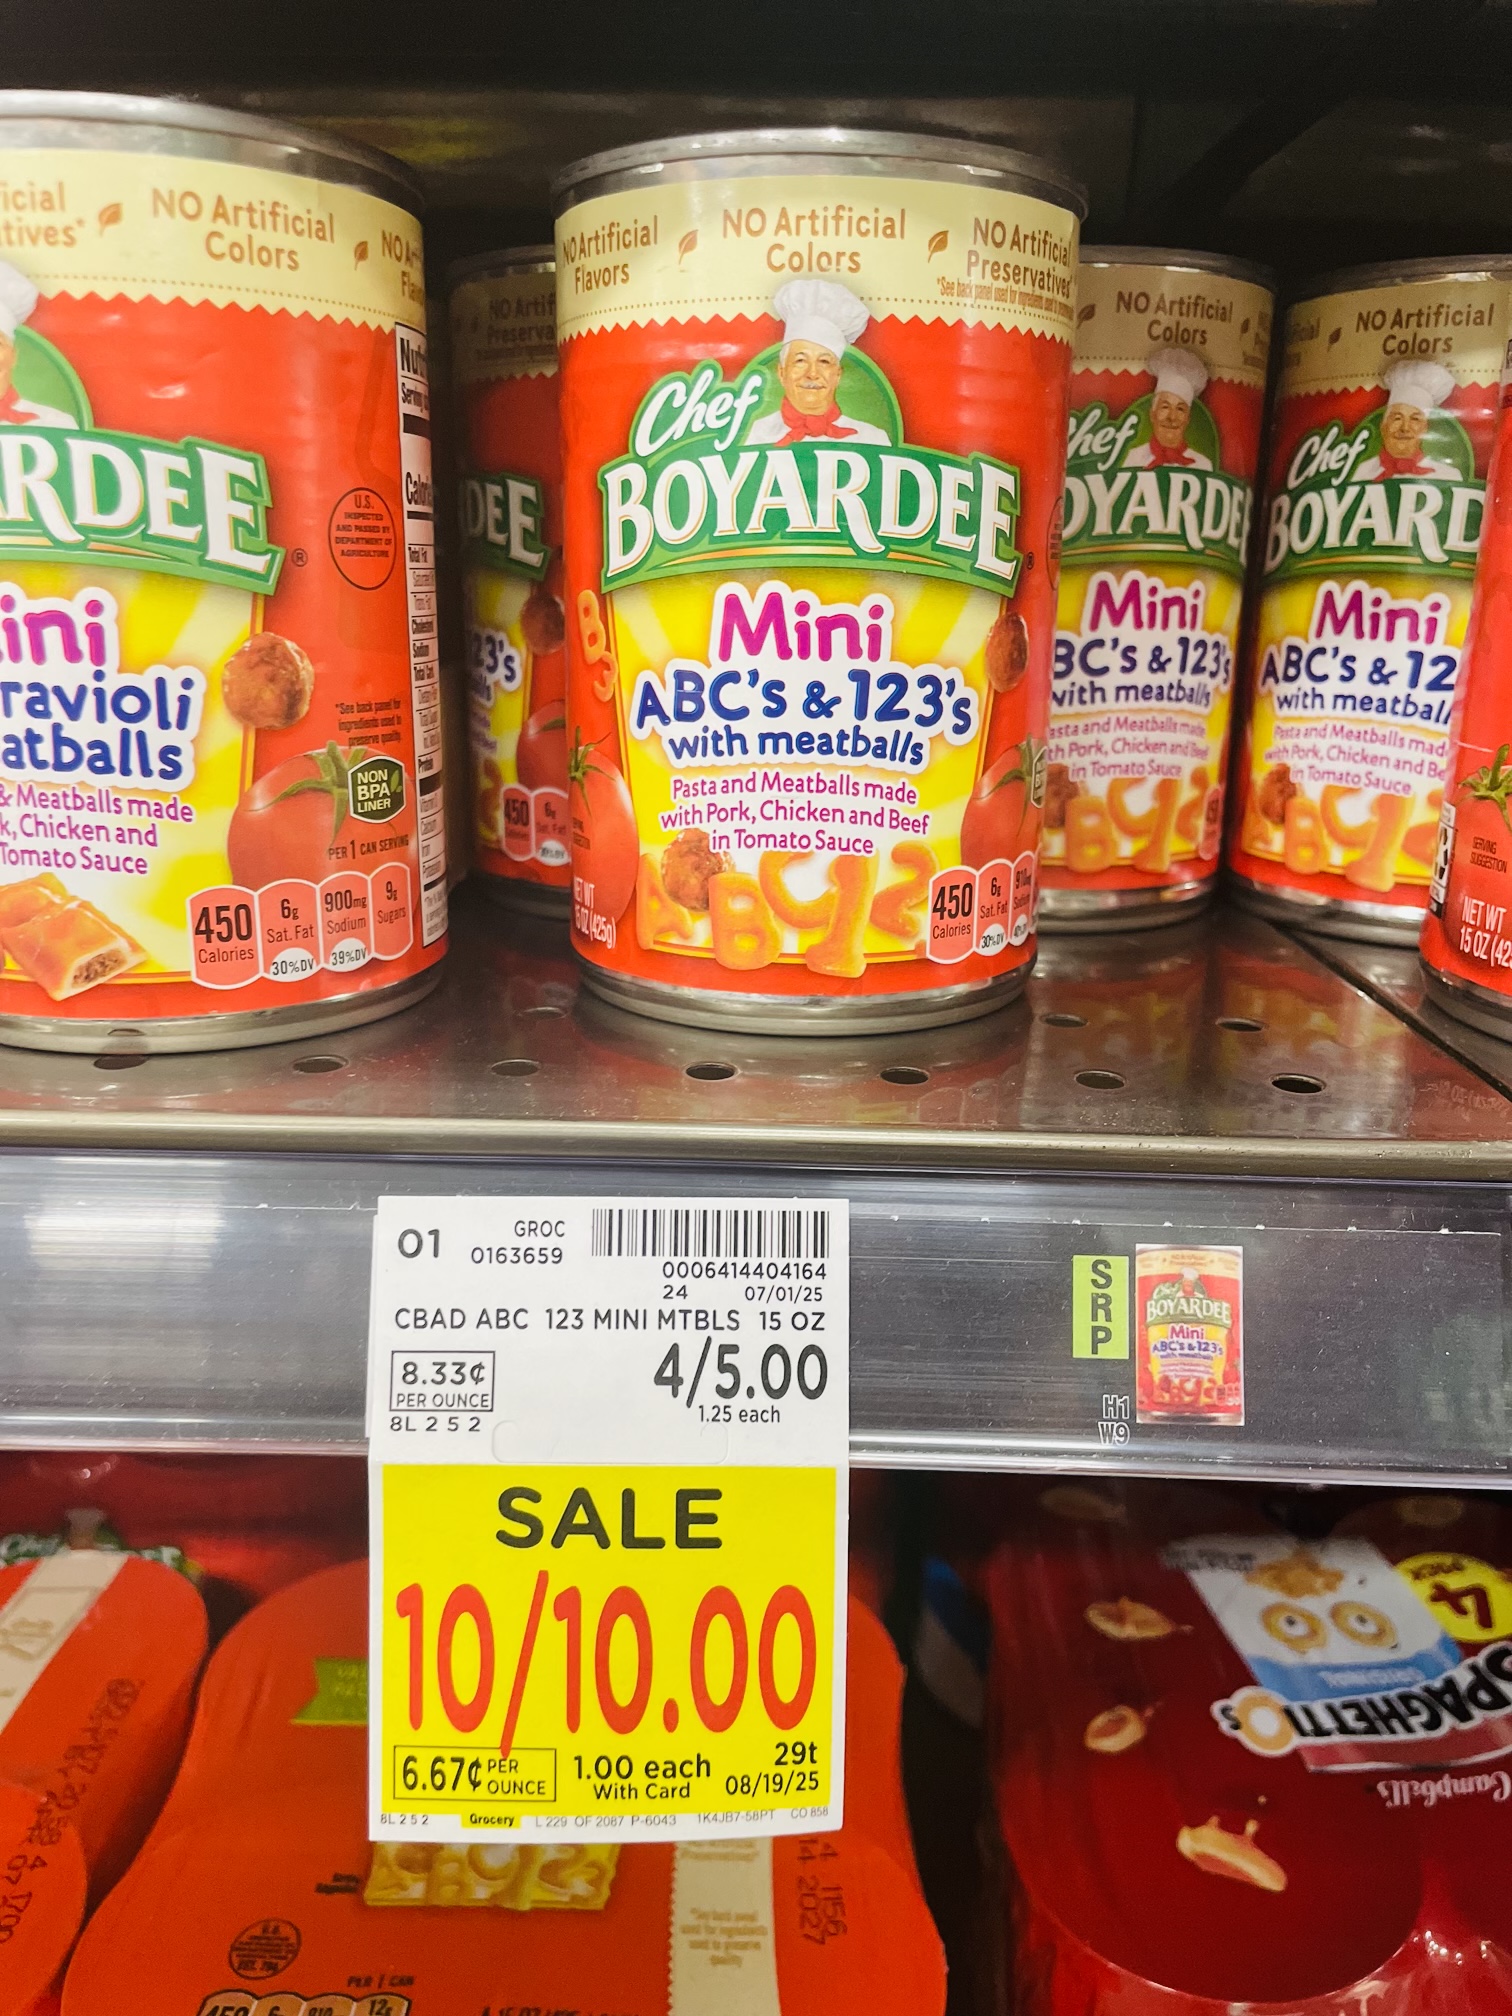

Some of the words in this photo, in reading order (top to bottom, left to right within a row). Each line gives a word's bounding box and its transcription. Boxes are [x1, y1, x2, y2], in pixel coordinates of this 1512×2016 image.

[152, 188, 203, 221] NO
[211, 195, 335, 243] Artificial
[722, 207, 767, 239] NO
[775, 205, 906, 240] Artificial
[381, 230, 403, 263] NO
[579, 215, 658, 260] Artificial
[974, 217, 1006, 249] NO
[1010, 224, 1072, 268] Artificial
[205, 231, 300, 272] Colors
[766, 241, 861, 274] Colors
[575, 262, 630, 296] Flavors
[1116, 292, 1150, 314] NO
[1155, 296, 1233, 323] Artificial
[1355, 309, 1386, 332] NO
[1390, 303, 1494, 330] Artificial
[1147, 319, 1207, 346] Colors
[1382, 333, 1452, 356] Colors
[634, 369, 764, 457] Chef
[1287, 428, 1369, 490] Chef
[604, 449, 1018, 580] BOYARDEE
[1089, 579, 1200, 632] Mini
[1315, 589, 1441, 645] Mini
[0, 594, 107, 667] ini
[718, 591, 884, 663] Mini
[1148, 650, 1172, 674] &
[1177, 636, 1231, 685] 123's
[1261, 645, 1357, 687] ABC's
[1367, 658, 1397, 685] &
[636, 668, 786, 730] ABC's
[803, 676, 841, 718] &
[848, 669, 972, 736] 123's
[1114, 680, 1212, 708] meatballs
[1276, 688, 1325, 713] with
[1082, 718, 1111, 735] and
[1113, 717, 1178, 733] Meatballs
[1332, 724, 1405, 749] Meatballs
[669, 727, 748, 760] with
[758, 727, 924, 766] meatballs
[1068, 740, 1108, 758] Pork,
[1111, 738, 1168, 755] Chicken
[1090, 761, 1146, 778] Tomato
[1148, 760, 1183, 777] Sauce
[1326, 745, 1390, 768] Chicken
[1393, 758, 1425, 777] and
[357, 769, 388, 784] NON
[672, 777, 717, 800] Pasta
[720, 773, 757, 796] and
[760, 771, 860, 797] Meatballs
[864, 780, 918, 806] made
[1308, 765, 1362, 786] Tomato
[1365, 772, 1412, 795] Sauce
[16, 786, 122, 816] Meatballs
[128, 793, 194, 823] made
[357, 784, 391, 801] BPA
[357, 798, 391, 813] LINER
[19, 812, 109, 843] Chicken
[116, 822, 158, 848] and
[660, 804, 703, 831] with
[706, 804, 756, 826] Pork,
[760, 801, 846, 823] Chicken
[849, 806, 885, 828] and
[888, 812, 930, 837] Beef
[329, 848, 348, 860] PER
[350, 840, 356, 859] 1
[361, 843, 377, 855] CAN
[380, 834, 409, 851] SERVING
[712, 830, 731, 850] in
[734, 829, 812, 854] Tomato
[815, 832, 874, 856] Sauce
[1472, 836, 1497, 855] SERVING
[0, 842, 76, 869] Tomato
[81, 849, 148, 875] Sauce
[1470, 852, 1507, 874] SUGGESTION
[386, 881, 398, 901] 9g
[991, 877, 1002, 897] 6g
[281, 899, 299, 920] 6g
[325, 889, 367, 912] 900mg
[932, 882, 973, 921] 450
[980, 905, 996, 919] Sat.
[997, 901, 1009, 915] Fat
[195, 904, 252, 943] 450
[327, 916, 367, 935] Sodium
[377, 907, 406, 925] Sugars
[1462, 896, 1485, 926] NET
[1485, 901, 1507, 934] WT
[267, 929, 293, 944] Sat.
[295, 924, 315, 939] Fat
[932, 923, 972, 940] Calories
[1459, 925, 1473, 954] 15
[1473, 931, 1491, 960] OZ
[199, 947, 254, 964] Calories
[272, 958, 315, 976] 30%DV
[331, 948, 367, 966] 39%DV
[514, 1220, 566, 1239] GROC
[397, 1228, 442, 1259] 01
[470, 1246, 564, 1266] 0163659
[662, 1261, 827, 1281] 0006414404164
[663, 1285, 688, 1301] 24
[744, 1285, 823, 1304] 07/01/25
[395, 1308, 467, 1331] CBAD
[475, 1308, 529, 1331] ABC
[545, 1309, 584, 1331] 123
[594, 1309, 648, 1331] MINI
[658, 1310, 740, 1332] MTBLS
[759, 1311, 782, 1332] 15
[791, 1311, 826, 1332] OZ
[1147, 1298, 1231, 1324] BOYARDEE
[1170, 1326, 1204, 1340] Mini
[401, 1361, 486, 1387] 8.33¢
[653, 1335, 829, 1408] 4/5.00
[396, 1393, 428, 1408] PER
[432, 1393, 490, 1409] OUNCE
[1102, 1394, 1130, 1420] H1
[390, 1416, 418, 1432] 8L
[424, 1416, 439, 1432] 2
[447, 1416, 460, 1432] 5
[468, 1416, 482, 1432] 2
[698, 1406, 732, 1424] 1.25
[738, 1406, 781, 1424] each
[1097, 1421, 1131, 1446] W9
[495, 1486, 723, 1549] SALE
[1430, 1583, 1493, 1630] 4
[396, 1569, 817, 1759] 10/10.00
[487, 1758, 520, 1774] PER
[573, 1755, 635, 1780] 1.00
[644, 1753, 711, 1780] each
[775, 1741, 818, 1767] 29t
[402, 1756, 482, 1792] 6.67¢
[725, 1771, 820, 1797] 08/19/25
[487, 1780, 547, 1796] OUNCE
[593, 1782, 639, 1801] With
[645, 1782, 691, 1801] Card
[1377, 1770, 1512, 1810] Campbell's
[380, 1813, 396, 1827] 8L
[399, 1814, 407, 1827] 2
[410, 1814, 418, 1827] 5
[421, 1814, 430, 1827] 2
[468, 1812, 516, 1829] Grocery
[546, 1816, 568, 1828] 229
[575, 1815, 593, 1828] OF
[596, 1815, 625, 1828] 2087
[631, 1814, 677, 1827] P-6043
[810, 1806, 829, 1819] 858
